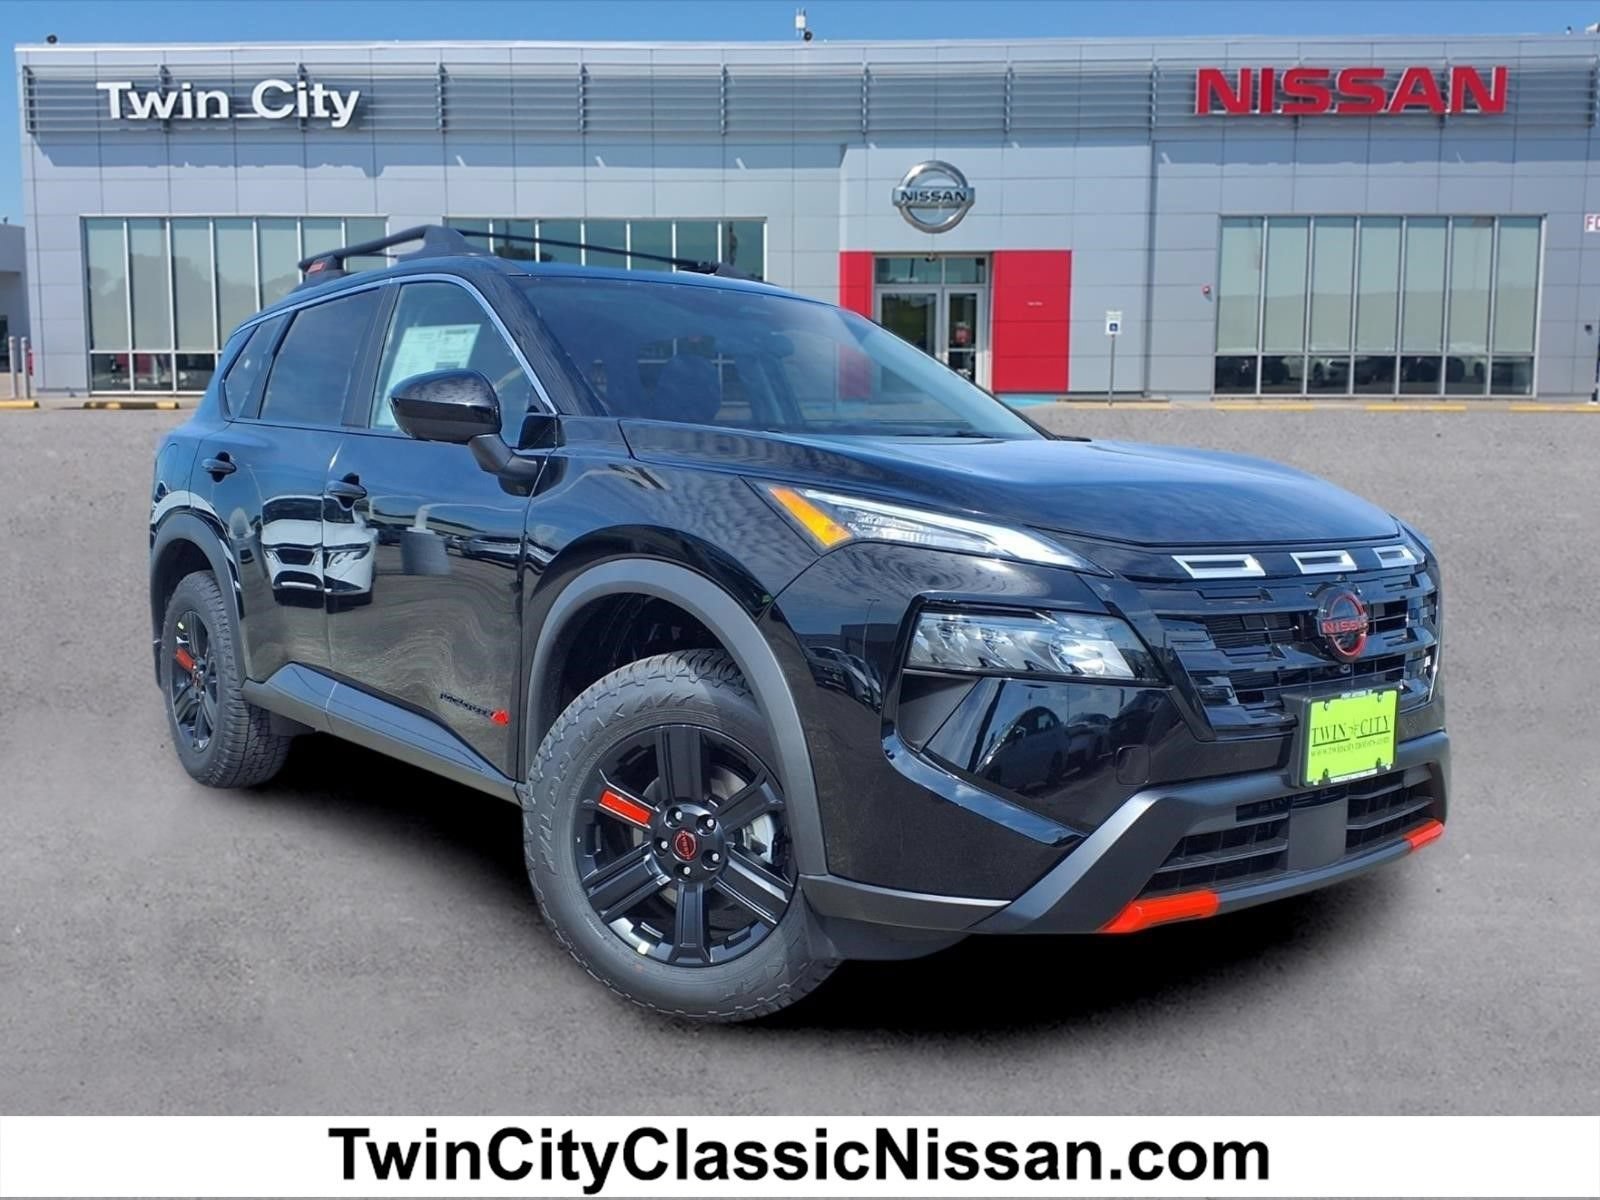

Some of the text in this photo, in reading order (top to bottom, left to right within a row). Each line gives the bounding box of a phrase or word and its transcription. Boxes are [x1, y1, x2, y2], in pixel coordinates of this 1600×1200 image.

[96, 79, 360, 128] Twin City
[1195, 66, 1508, 116] NISSAN
[901, 191, 967, 202] NISSAN
[1311, 714, 1392, 745] TWIN CITY
